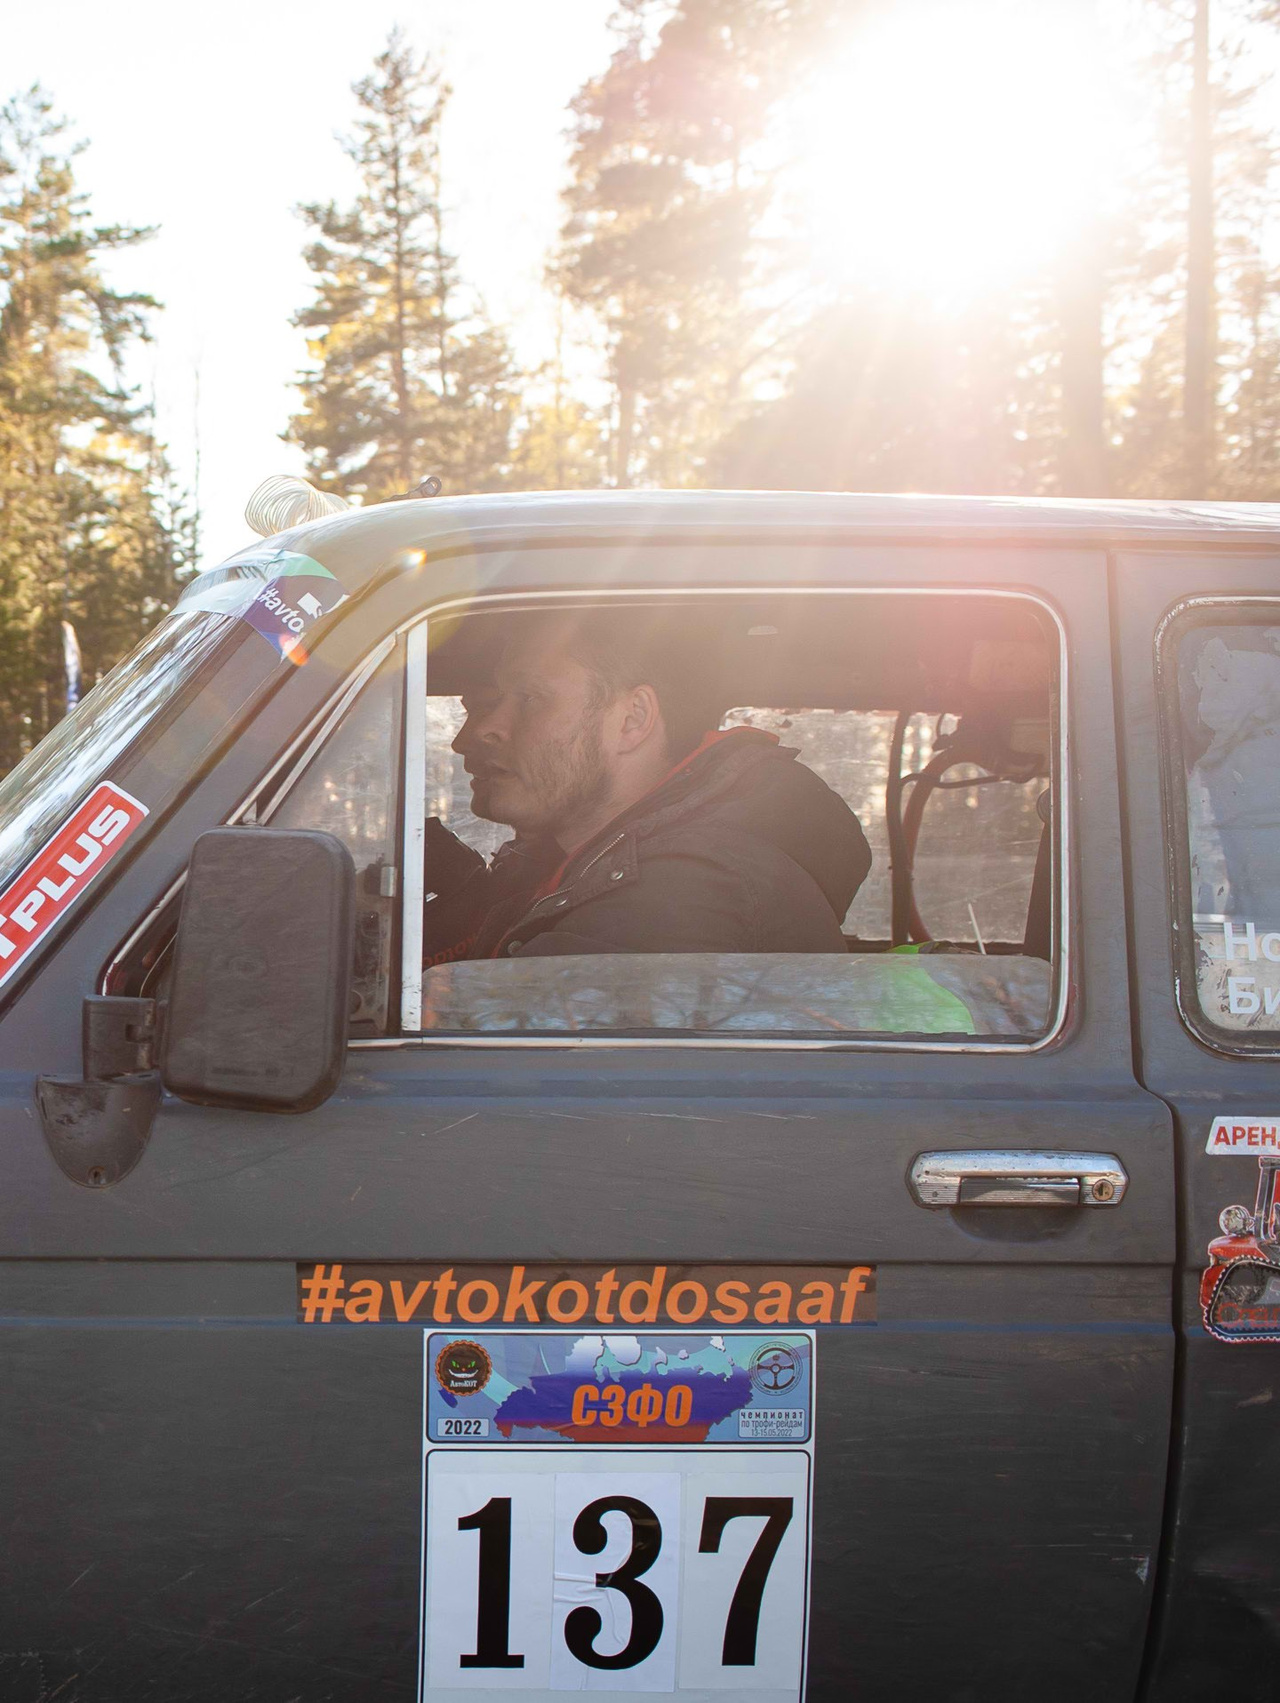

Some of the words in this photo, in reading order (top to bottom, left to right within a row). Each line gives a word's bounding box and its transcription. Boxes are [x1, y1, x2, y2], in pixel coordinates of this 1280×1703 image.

[1214, 1126, 1280, 1149] АРЕН
[301, 1264, 871, 1324] #avtokotdosaaf
[571, 1383, 693, 1427] СЗФО
[740, 1411, 803, 1419] чемпионат
[444, 1420, 482, 1435] 2022
[457, 1496, 794, 1671] 137
